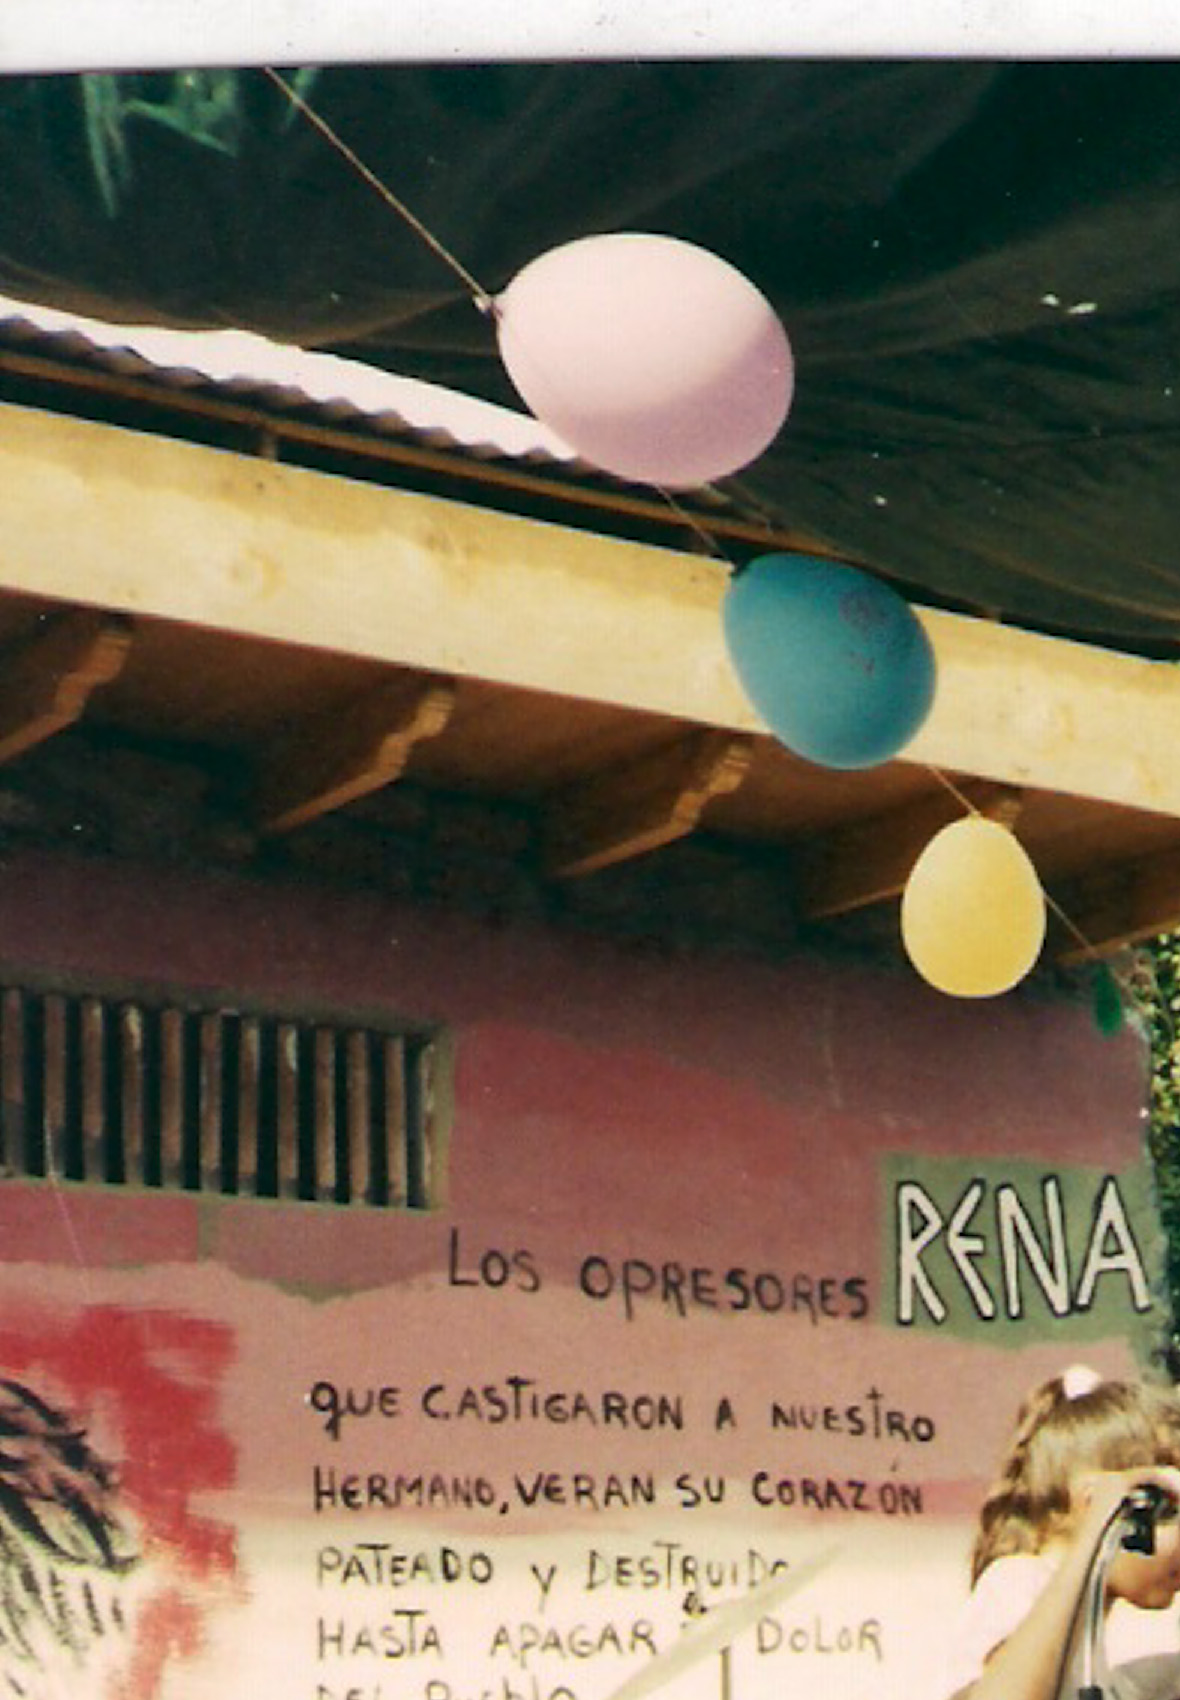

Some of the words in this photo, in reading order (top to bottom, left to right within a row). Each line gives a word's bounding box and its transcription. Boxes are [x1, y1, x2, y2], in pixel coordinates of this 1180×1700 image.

[447, 1228, 541, 1294] LOS
[579, 1255, 871, 1327] OPRESORES
[896, 1175, 1153, 1327] RENA
[421, 1375, 683, 1430] CASTIGARON
[715, 1396, 737, 1431] A
[771, 1386, 936, 1442] NUESTRO
[514, 1471, 656, 1512] VERAN
[676, 1473, 726, 1508] SU
[752, 1455, 925, 1515] CORAZÓN
[317, 1542, 495, 1591] PATEADO
[317, 1609, 445, 1661] HASTA
[489, 1618, 660, 1669] APAGAR
